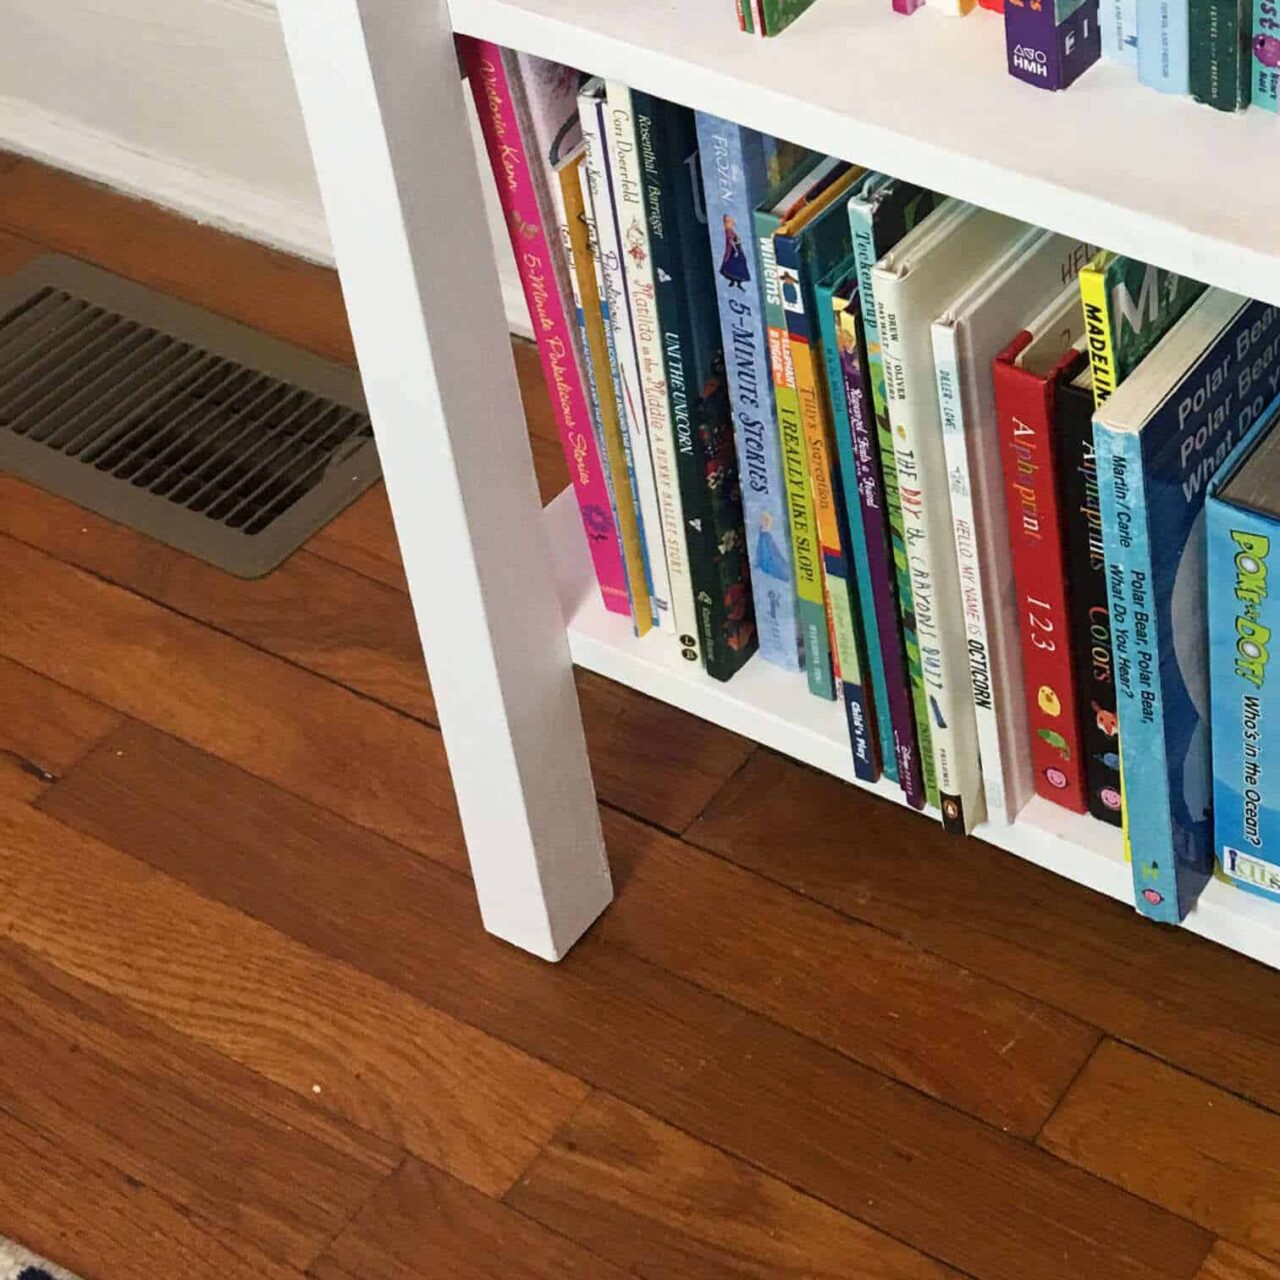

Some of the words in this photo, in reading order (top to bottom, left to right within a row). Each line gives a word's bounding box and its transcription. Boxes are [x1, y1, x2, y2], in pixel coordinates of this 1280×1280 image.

[1013, 55, 1047, 77] HMH
[638, 115, 658, 176] Rosenthal
[760, 237, 780, 306] Willems
[854, 232, 878, 329] Teckentrup
[664, 331, 683, 359] UNI
[888, 313, 899, 344] DREW
[729, 297, 761, 410] 5-MINUTE
[669, 361, 686, 389] THE
[894, 364, 906, 401] OLIVER
[1178, 353, 1232, 431] Polar
[671, 389, 695, 458] UNICORN
[1180, 391, 1233, 469] Polar
[739, 406, 770, 497] STORIES
[783, 418, 805, 489] REALLY
[897, 450, 918, 481] THE
[1110, 455, 1127, 502] Martin
[791, 490, 809, 537] LIKE
[900, 487, 922, 521] DAY
[1117, 510, 1133, 549] Carle
[796, 538, 815, 583] SLOP!
[1107, 563, 1125, 603] What
[1130, 569, 1147, 611] Polar
[1112, 605, 1127, 624] Do
[1135, 612, 1151, 646] Bear,
[1115, 628, 1130, 656] You
[967, 639, 993, 711] OCTICORN
[1118, 658, 1136, 700] Hear?
[1137, 650, 1153, 688] Polar
[1141, 690, 1158, 725] Bear,
[1243, 693, 1264, 741] Who's
[1245, 743, 1262, 761] in
[1246, 762, 1263, 788] the
[1247, 788, 1265, 848] Ocean?
